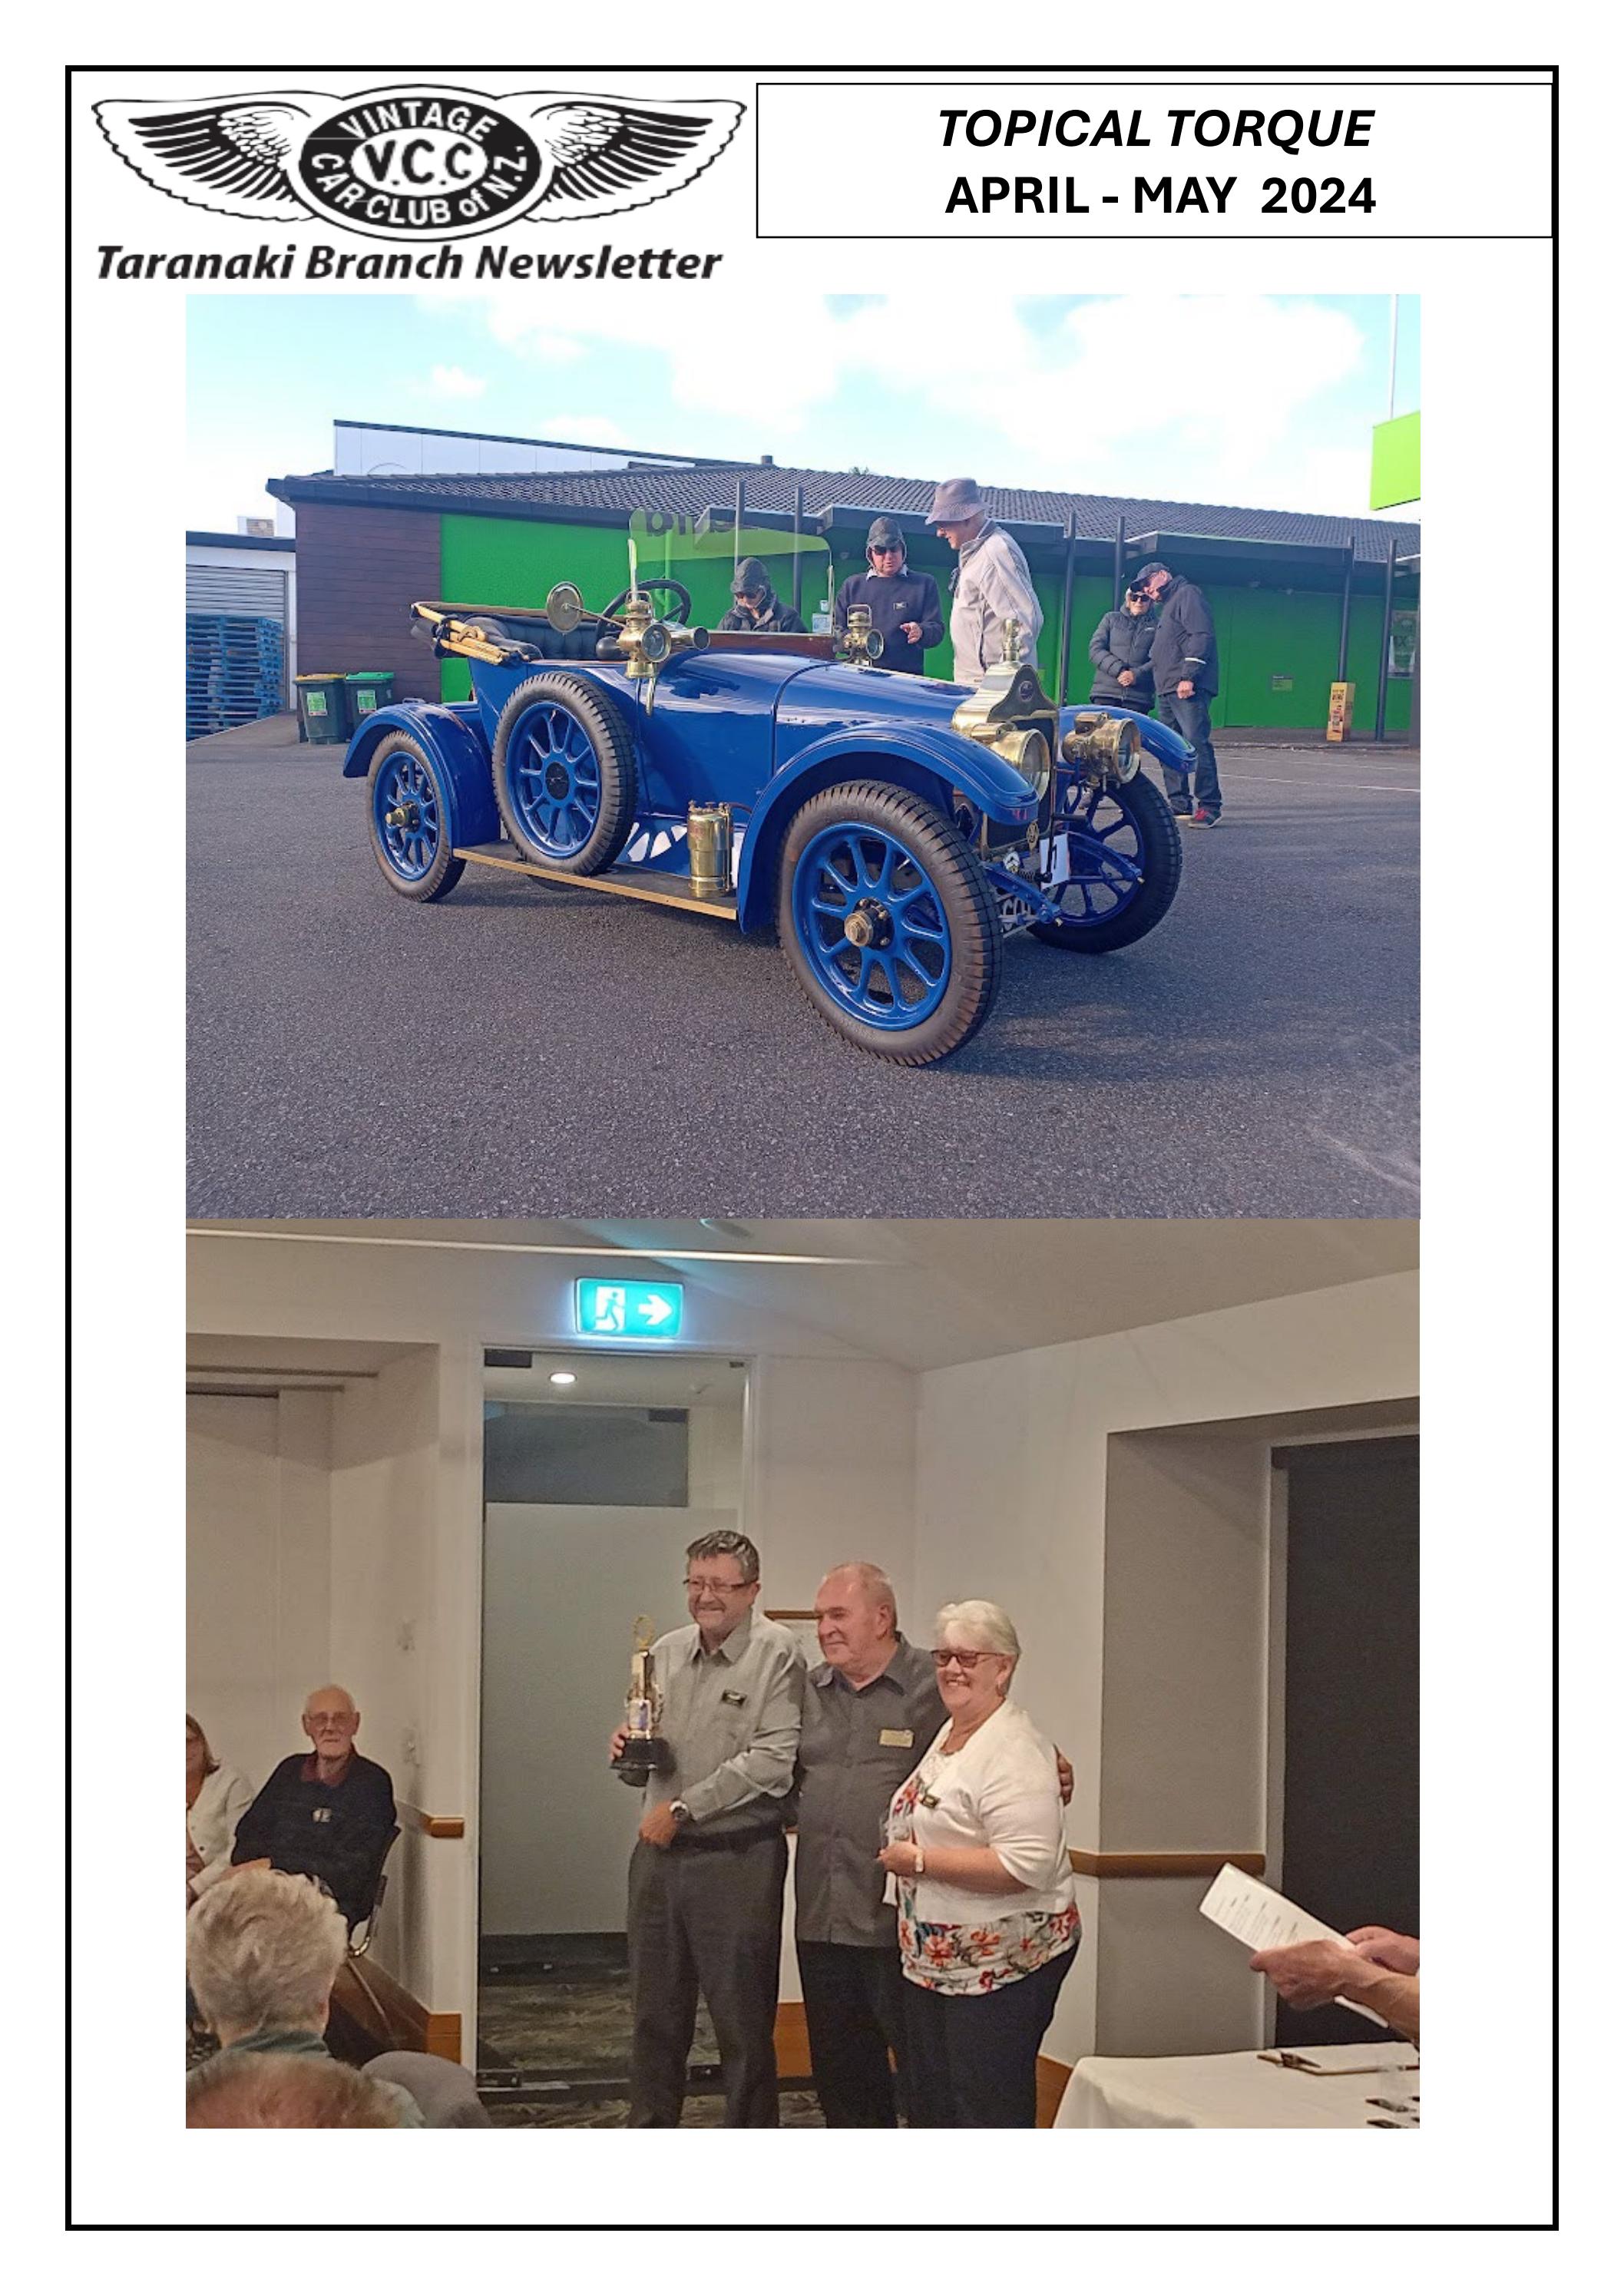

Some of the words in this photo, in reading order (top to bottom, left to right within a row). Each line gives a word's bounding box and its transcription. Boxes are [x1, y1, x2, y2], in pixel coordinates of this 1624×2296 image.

[338, 101, 499, 141] VINTAGE
[940, 110, 1150, 147] TOPICAL
[1168, 110, 1375, 155] TORQUE
[312, 154, 366, 209] CAR
[366, 194, 451, 224] CLUB
[459, 188, 490, 217] of
[482, 146, 528, 199] N.Z.
[945, 177, 1089, 213] APRIL
[1135, 177, 1237, 213] MAY
[1262, 177, 1376, 213] 2024
[98, 244, 296, 279] Taranaki
[306, 246, 462, 279] Branch
[475, 246, 723, 280] Newsletter
